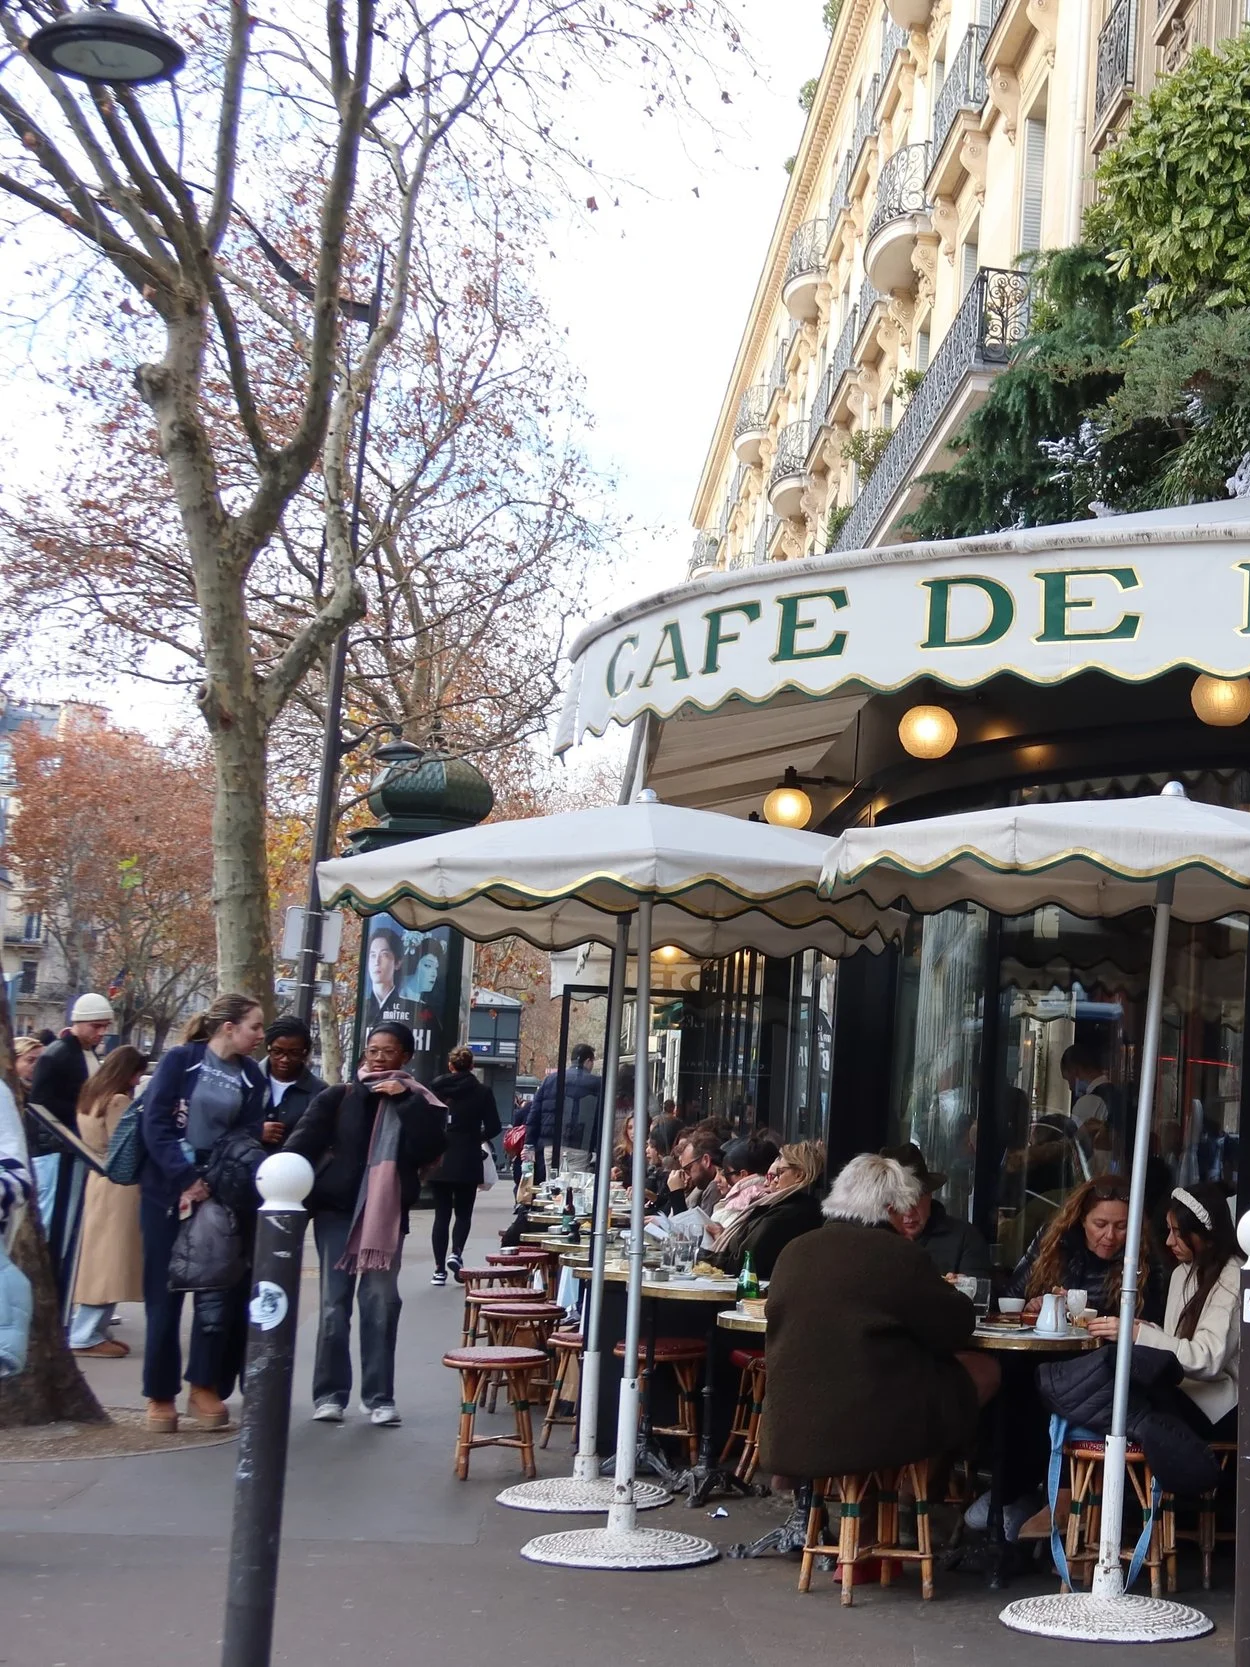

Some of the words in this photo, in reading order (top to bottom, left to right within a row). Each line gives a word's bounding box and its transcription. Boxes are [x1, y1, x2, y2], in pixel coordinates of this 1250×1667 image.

[604, 585, 850, 699] CAFE
[917, 564, 1143, 649] DE
[393, 1002, 400, 1010] LE
